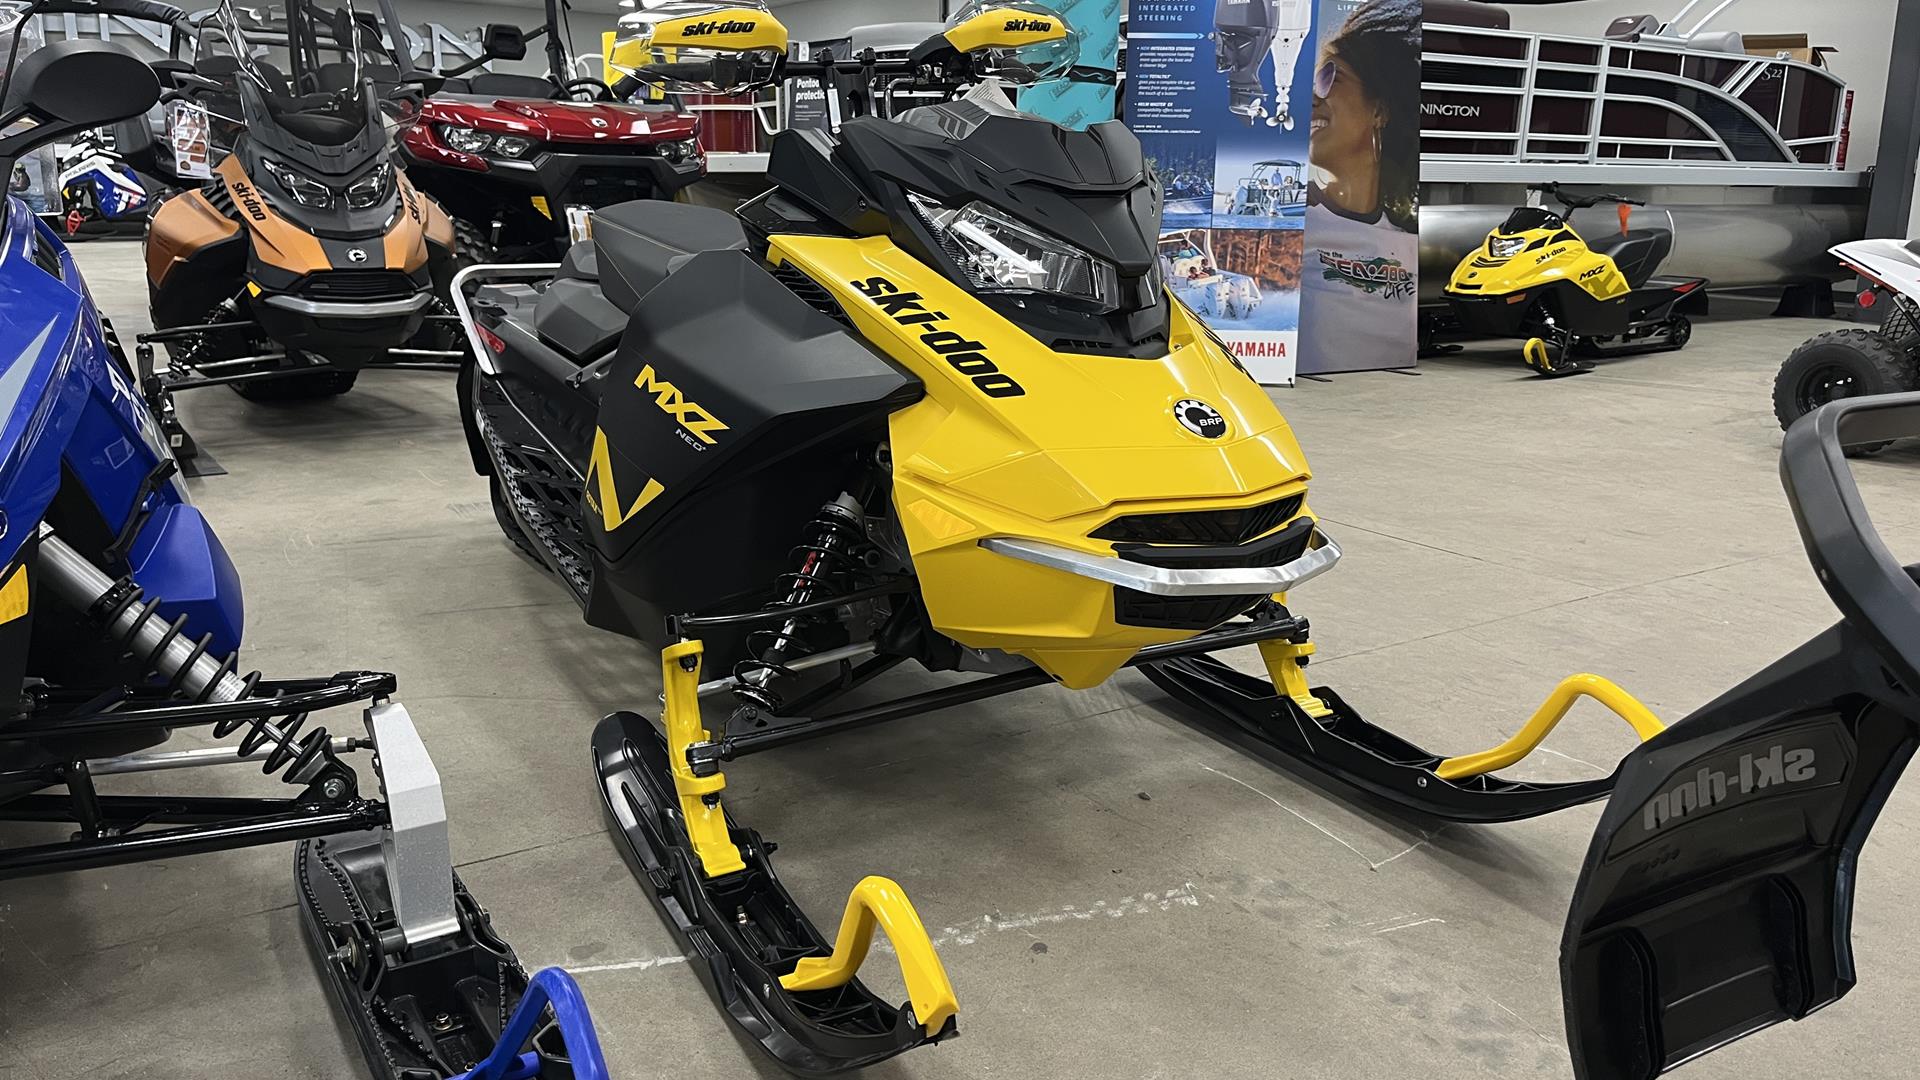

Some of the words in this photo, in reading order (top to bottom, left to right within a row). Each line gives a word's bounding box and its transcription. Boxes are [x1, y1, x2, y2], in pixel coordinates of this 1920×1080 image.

[1138, 4, 1196, 12] INTEGRATED
[1337, 4, 1359, 12] LIFE
[682, 20, 756, 36] ski-doo
[1003, 18, 1052, 32] ski-doo
[1420, 103, 1480, 117] NINGTON
[232, 181, 267, 222] ski-doo
[1535, 246, 1567, 265] ski-doo
[1579, 263, 1607, 281] MXZ
[1383, 280, 1417, 300] LIFE
[850, 276, 1026, 399] ski-doo
[1226, 341, 1287, 358] YAMAHA
[633, 363, 731, 445] MXZ
[1199, 417, 1223, 427] BRP
